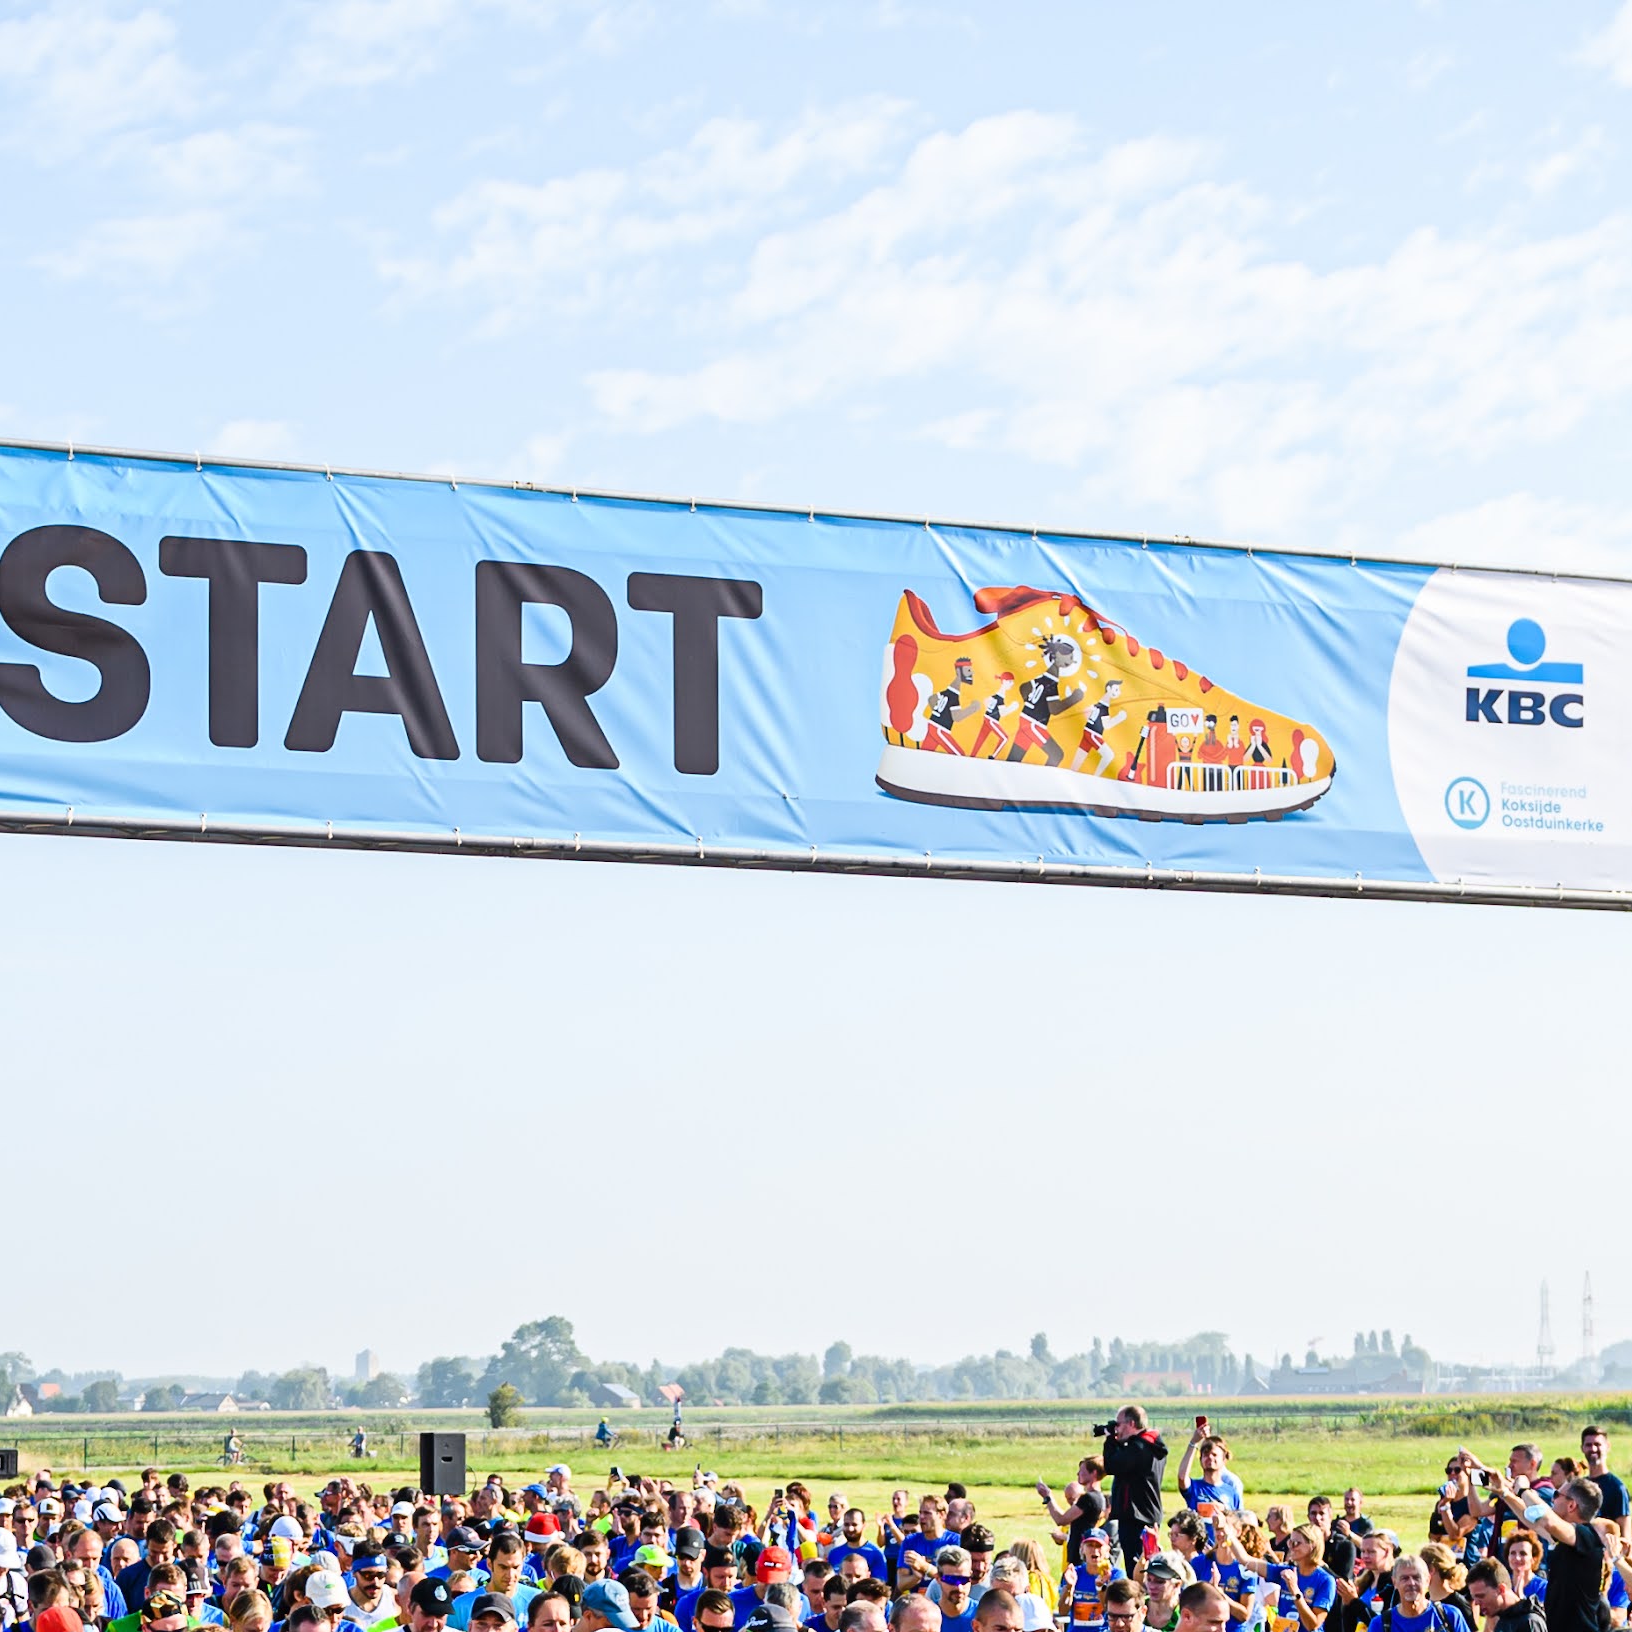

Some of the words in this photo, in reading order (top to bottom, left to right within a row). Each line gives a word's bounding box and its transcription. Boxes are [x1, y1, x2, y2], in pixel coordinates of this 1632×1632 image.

[1466, 687, 1584, 728] KBC
[1171, 713, 1190, 728] GO
[1500, 781, 1586, 799] Fascinerend
[1459, 789, 1476, 816] K
[1501, 799, 1561, 815] Koksijde
[1502, 814, 1604, 832] Oostduinkerke
